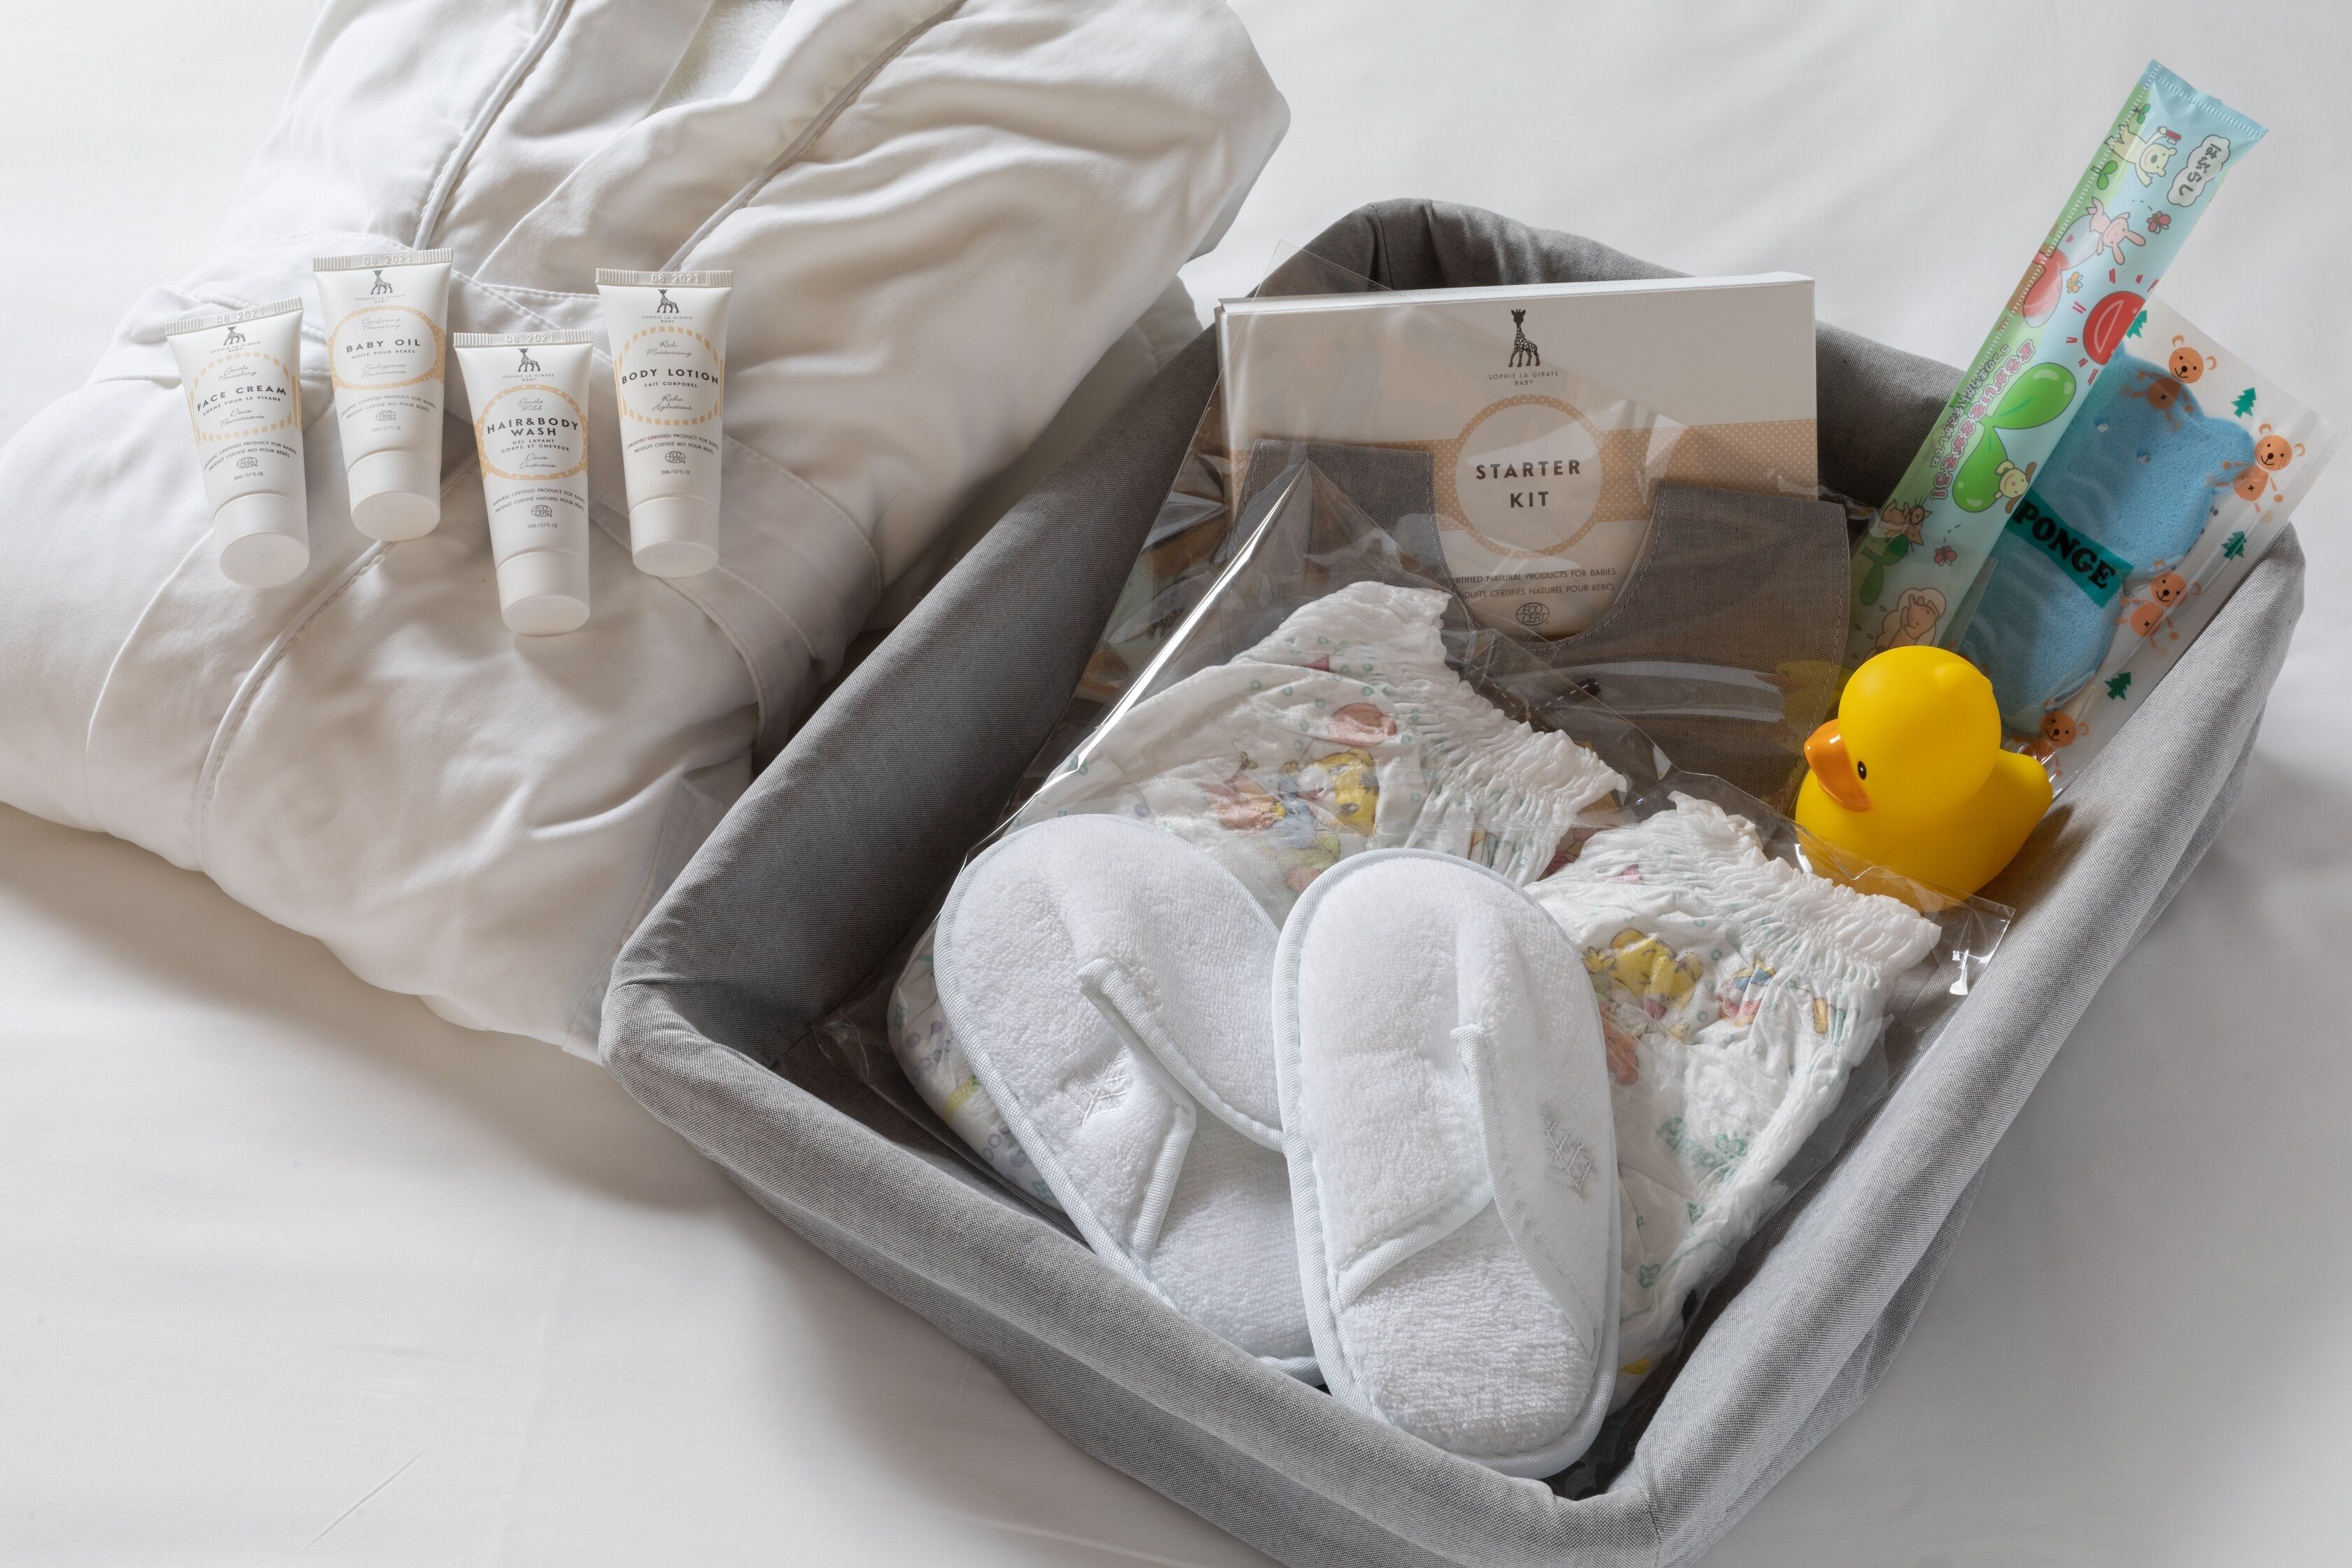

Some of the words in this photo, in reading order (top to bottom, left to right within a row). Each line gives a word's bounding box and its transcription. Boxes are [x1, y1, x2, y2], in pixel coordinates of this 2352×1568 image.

[2179, 144, 2222, 196] はぶらし
[364, 256, 377, 265] 08
[386, 254, 412, 264] 2021
[651, 273, 664, 284] 08
[673, 274, 699, 284] 2021
[217, 315, 230, 323] 08
[239, 308, 263, 321] 2021
[527, 334, 554, 342] 2021
[346, 340, 384, 353] BABY
[622, 369, 657, 384] BODY
[668, 369, 718, 385] LOTION
[197, 391, 226, 412] FACE
[236, 385, 286, 396] CREAM
[359, 396, 382, 405] CERTIFIED
[203, 402, 221, 416] CRÈME
[225, 398, 242, 406] POUR
[487, 417, 578, 434] HAIR&BODY
[511, 428, 556, 437] WASH
[219, 444, 241, 455] CERTIFIED
[627, 438, 646, 449] ORGANIC
[634, 444, 653, 454] PRODUIT
[1476, 459, 1581, 481] STARTER
[493, 494, 510, 507] NATURAL
[512, 489, 535, 497] CERTIFIED
[1510, 491, 1550, 509] KIT
[495, 502, 512, 514] PRODUIT
[2012, 500, 2115, 589] PONGE
[1454, 575, 1483, 584] RTIFIED
[1487, 574, 1521, 582] NATURAL
[1525, 570, 1567, 580] PRODUCTS
[1463, 591, 1487, 599] DUITS
[1490, 587, 1525, 597] CERTIFIÉS
[1566, 584, 1588, 593] POUR
[1592, 583, 1614, 592] BÉBÉS
[1522, 606, 1543, 615] ECO
[1522, 613, 1546, 623] CERT
